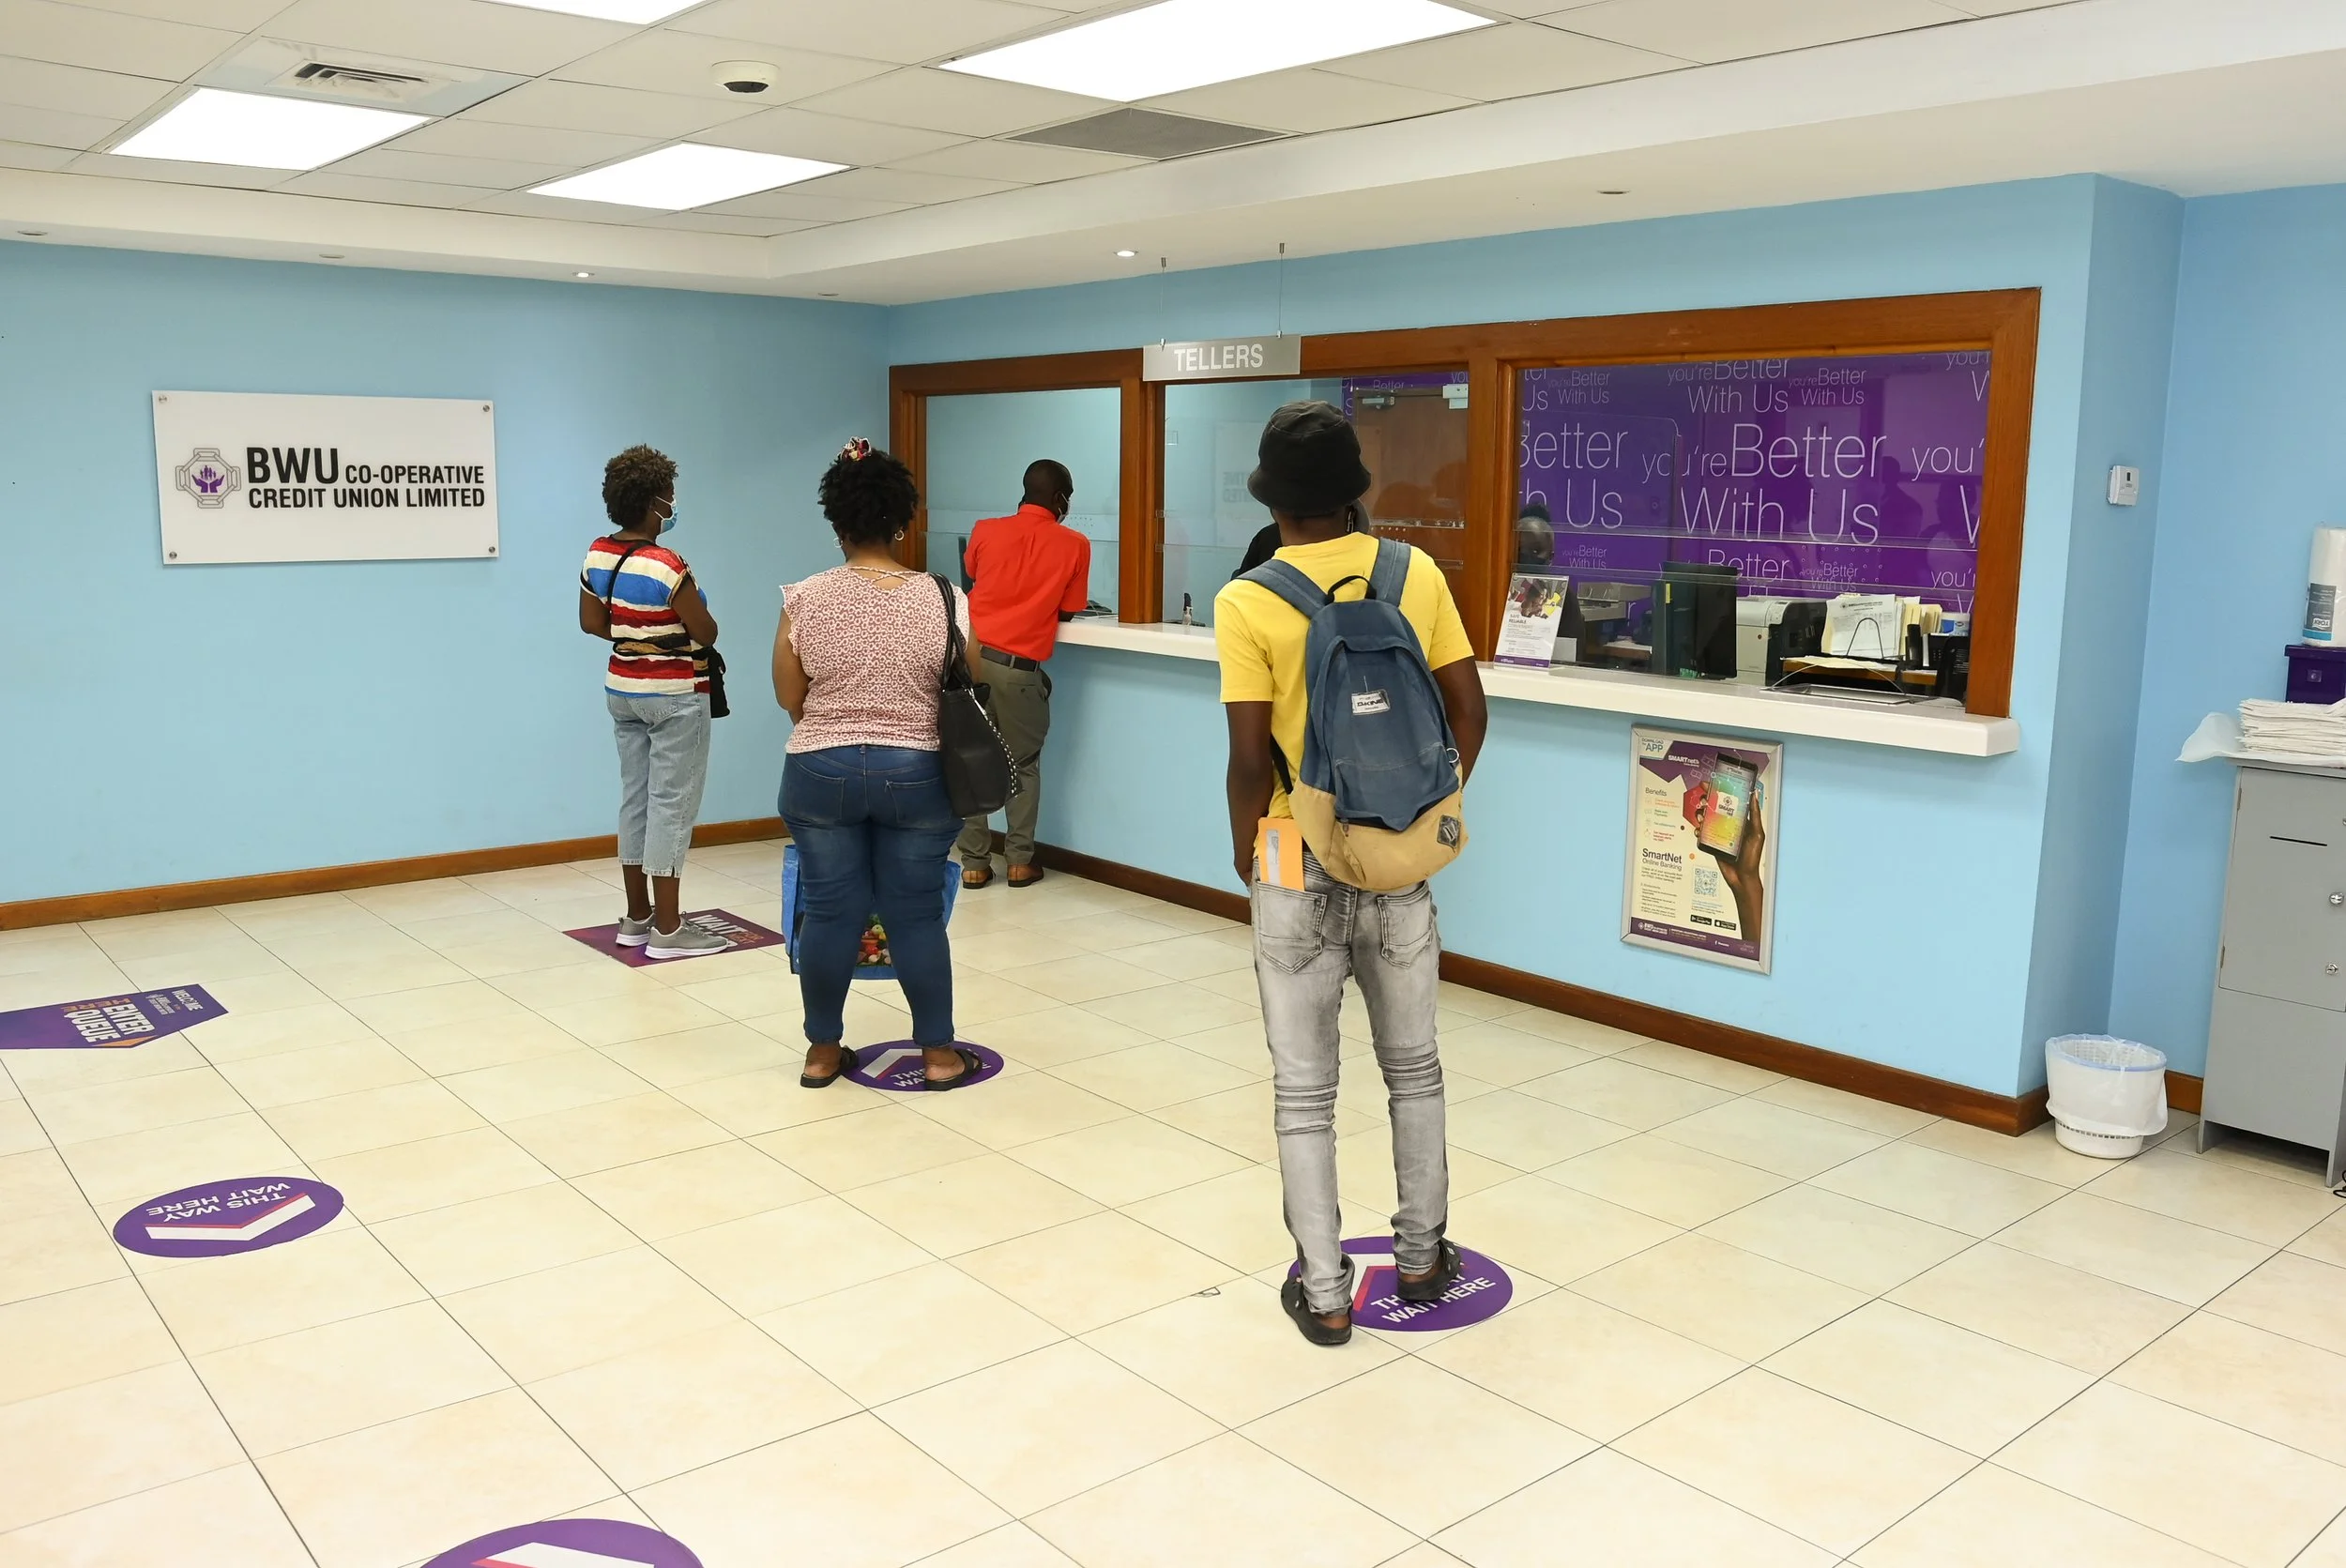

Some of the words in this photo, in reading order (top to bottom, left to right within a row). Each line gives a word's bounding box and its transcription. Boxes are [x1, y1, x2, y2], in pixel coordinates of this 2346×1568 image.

[1174, 343, 1264, 372] TELLERS
[1572, 370, 1610, 387] Better
[1818, 367, 1867, 387] Better
[1558, 388, 1587, 405] With
[1591, 387, 1610, 404] Us
[1687, 385, 1742, 414] With
[1753, 383, 1790, 413] Us
[1801, 388, 1836, 406] With
[1842, 386, 1865, 405] Us
[1731, 424, 1887, 478] Better
[1912, 437, 1986, 481] you'
[246, 447, 339, 484] BWU
[344, 464, 484, 484] CO-OPERATIVE
[249, 488, 326, 509] CREDIT
[333, 488, 400, 509] UNION
[406, 488, 485, 508] LIMITED
[1566, 478, 1623, 529] Us
[1681, 486, 1785, 540] With
[1808, 488, 1880, 545] Us
[1578, 544, 1607, 558] Better
[1823, 562, 1859, 578] Better
[1645, 743, 1664, 753] APP
[1645, 787, 1668, 797] Benefits
[1642, 848, 1683, 864] SmartNet
[1642, 858, 1659, 867] Online
[1659, 860, 1683, 872] Banking
[64, 1009, 121, 1043] QUEUE
[102, 1003, 155, 1035] ENTER
[226, 1193, 286, 1209] THIS
[227, 1182, 291, 1201] WAIT
[145, 1195, 220, 1216] HERE
[163, 1205, 221, 1223] WAY
[1381, 1300, 1439, 1323] WAIT
[1440, 1276, 1497, 1303] HERE
